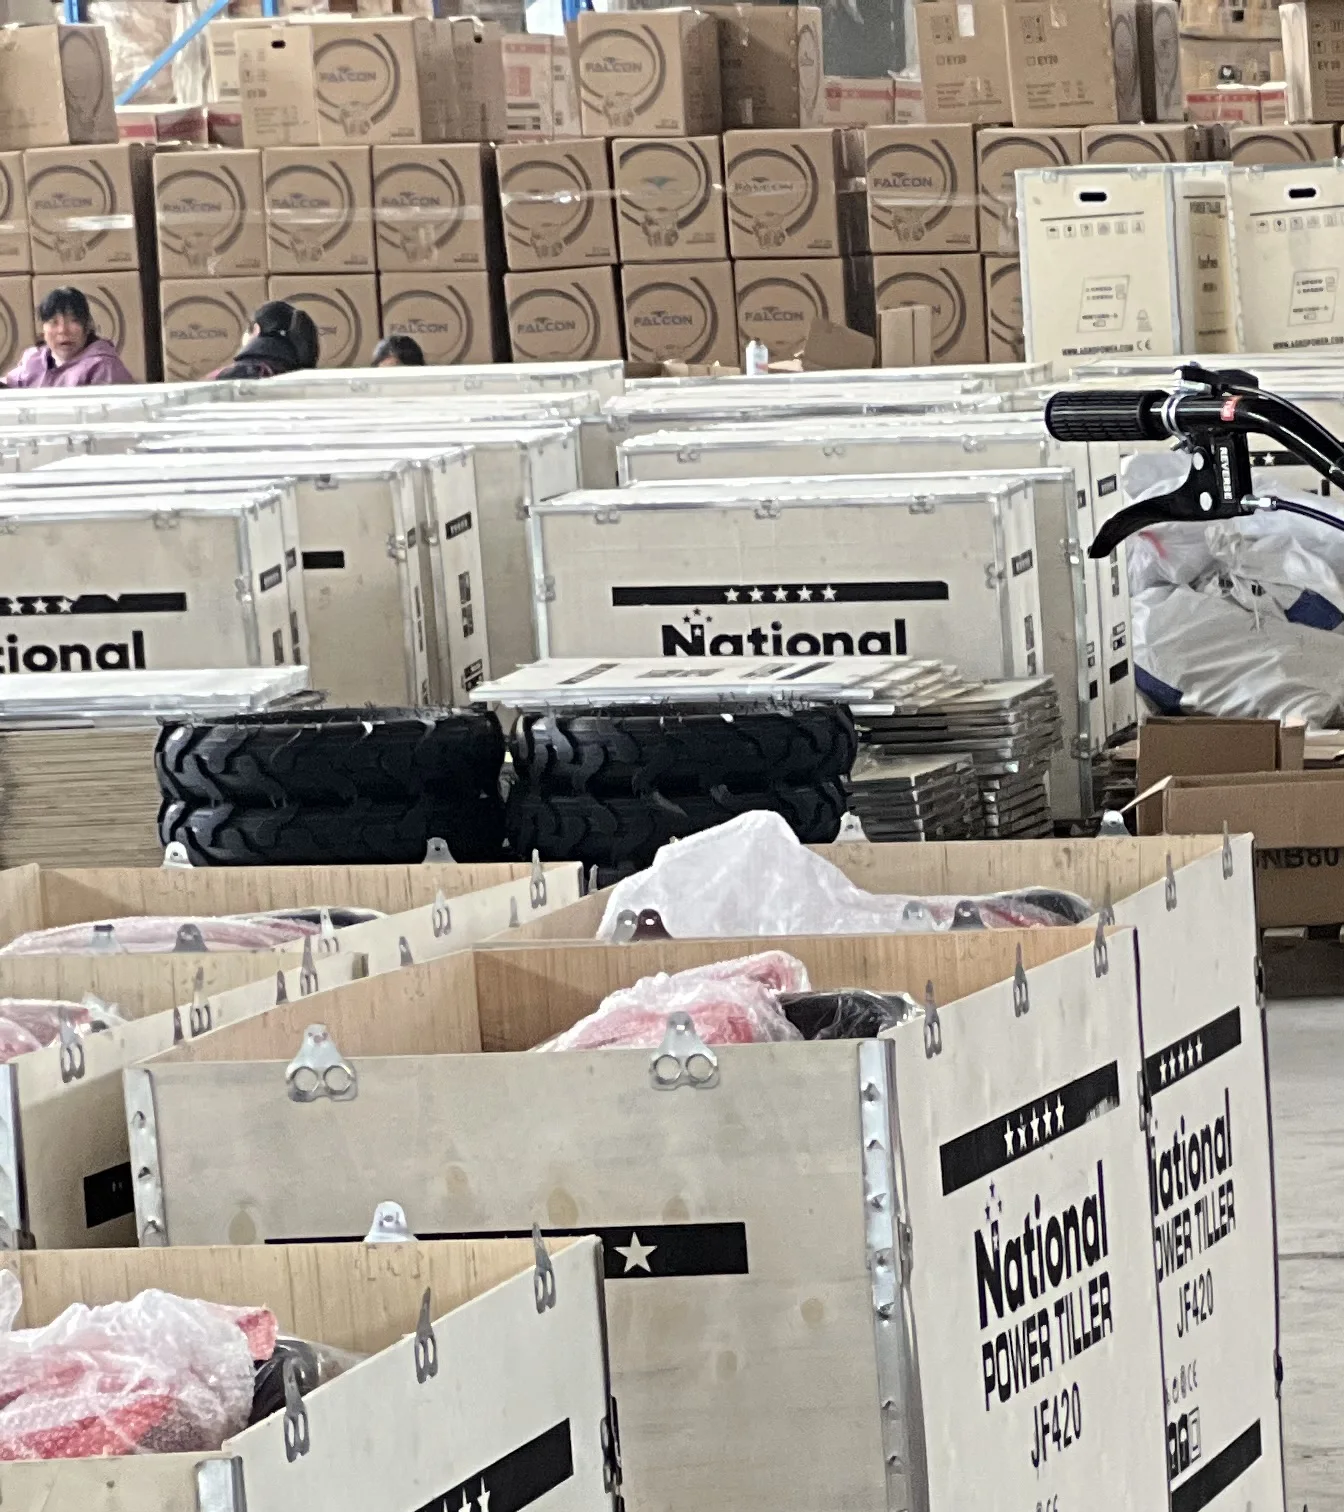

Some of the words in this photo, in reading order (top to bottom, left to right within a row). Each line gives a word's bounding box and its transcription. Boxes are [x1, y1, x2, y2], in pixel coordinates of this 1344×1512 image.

[585, 61, 642, 73] FALCON
[319, 71, 377, 82] FALCON
[873, 177, 932, 188] FALCON
[35, 195, 92, 209] FALCON
[161, 201, 222, 213] FALCON
[271, 196, 331, 207] FALCON
[381, 195, 440, 207] FALCON
[634, 314, 693, 327] FALCON
[744, 310, 804, 322] FALCON
[389, 322, 448, 334] FALCON
[517, 319, 576, 332] FALCON
[170, 328, 228, 340] FALCON
[1219, 446, 1233, 500] REVERSE
[661, 616, 907, 657] National
[1193, 1178, 1237, 1256] TILLER
[974, 1160, 1110, 1330] National
[1176, 1268, 1215, 1338] JF420
[981, 1311, 1056, 1412] POWER
[1053, 1271, 1114, 1364] TILLER
[1030, 1400, 1083, 1471] JF420
